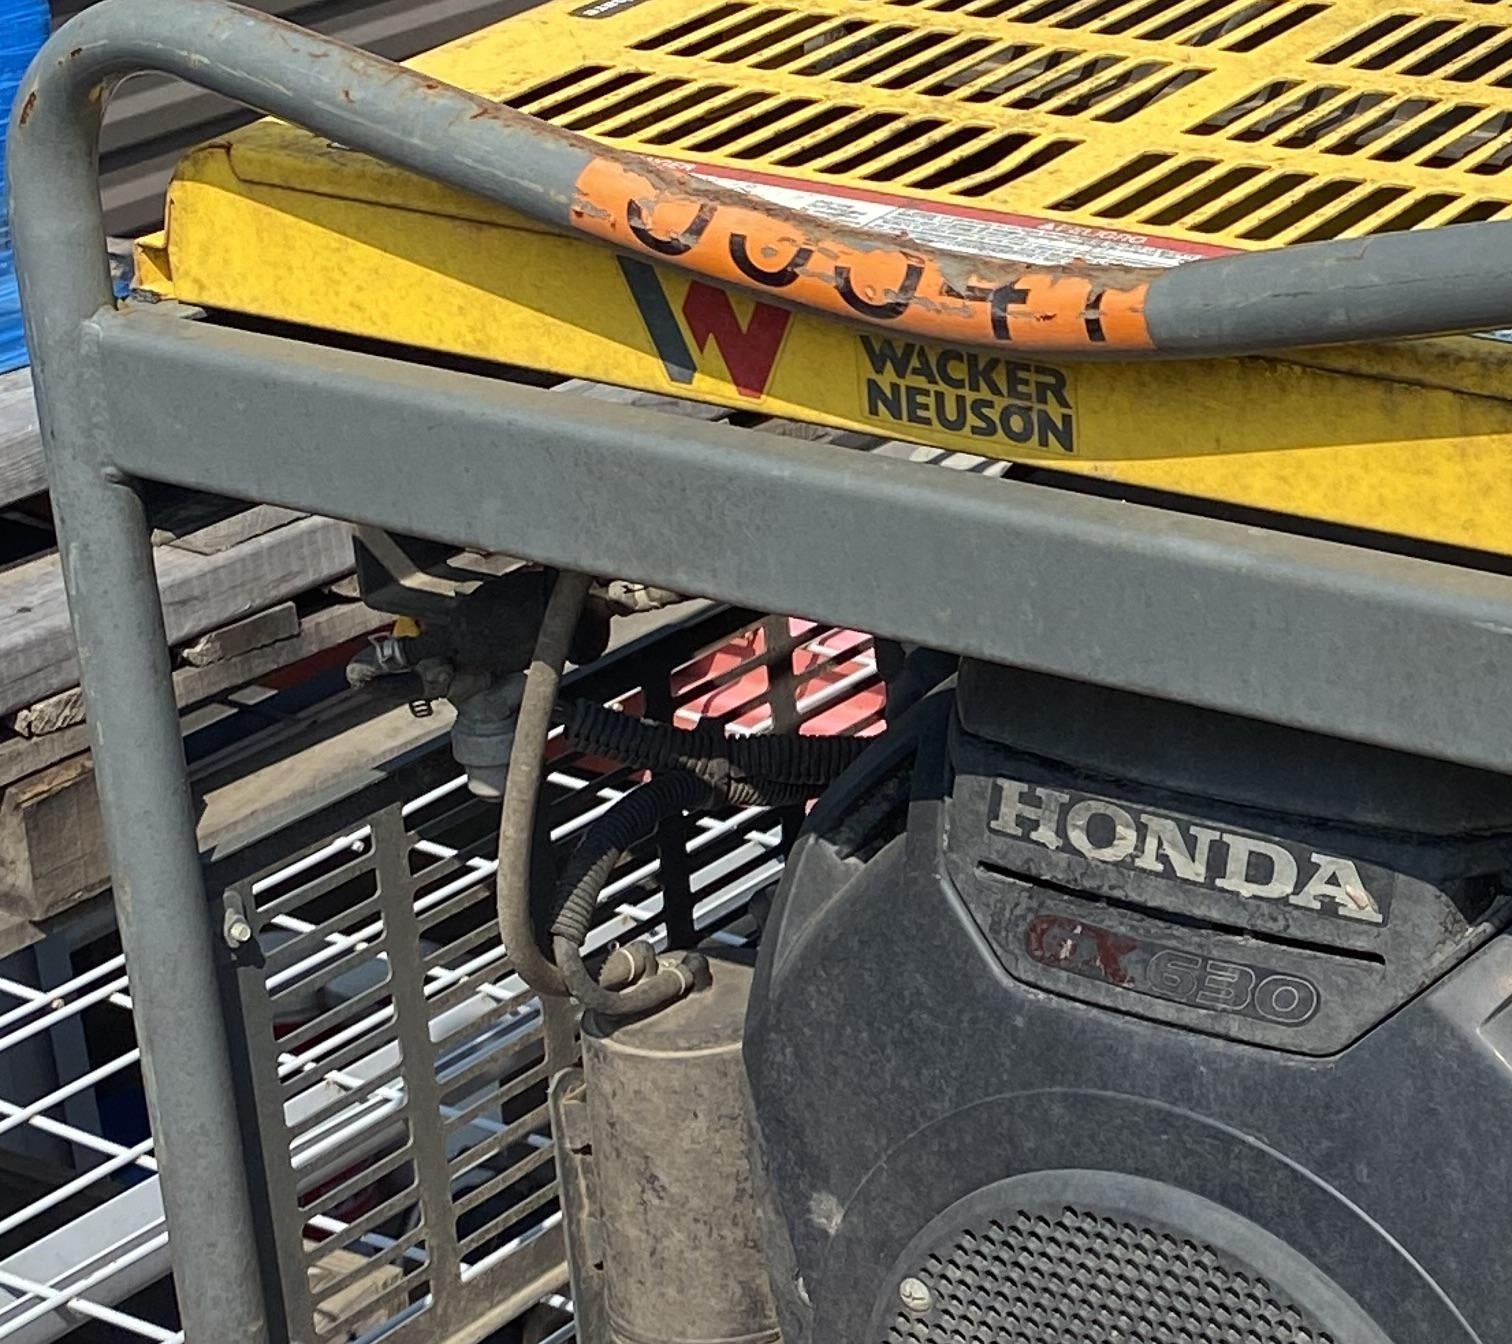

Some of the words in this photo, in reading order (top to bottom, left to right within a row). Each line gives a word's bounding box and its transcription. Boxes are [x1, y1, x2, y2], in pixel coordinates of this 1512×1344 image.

[858, 335, 1072, 410] WACKER
[866, 378, 1074, 453] NEUSON
[989, 776, 1383, 923] HONDA
